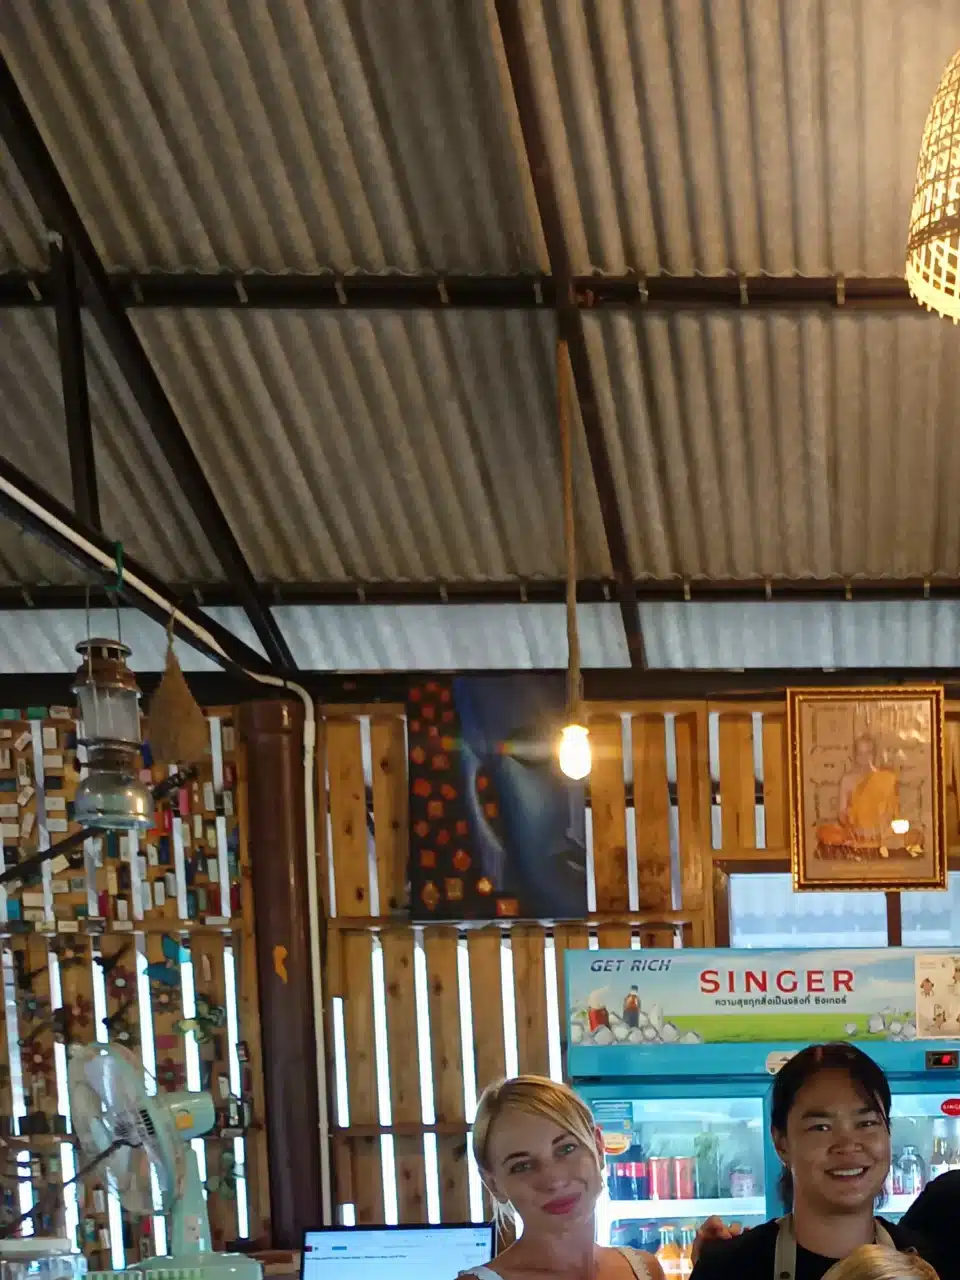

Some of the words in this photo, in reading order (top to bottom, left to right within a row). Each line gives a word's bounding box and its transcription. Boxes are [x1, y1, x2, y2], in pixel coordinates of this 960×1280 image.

[590, 959, 625, 972] GET
[630, 959, 672, 972] RICH
[699, 969, 856, 994] SINGER
